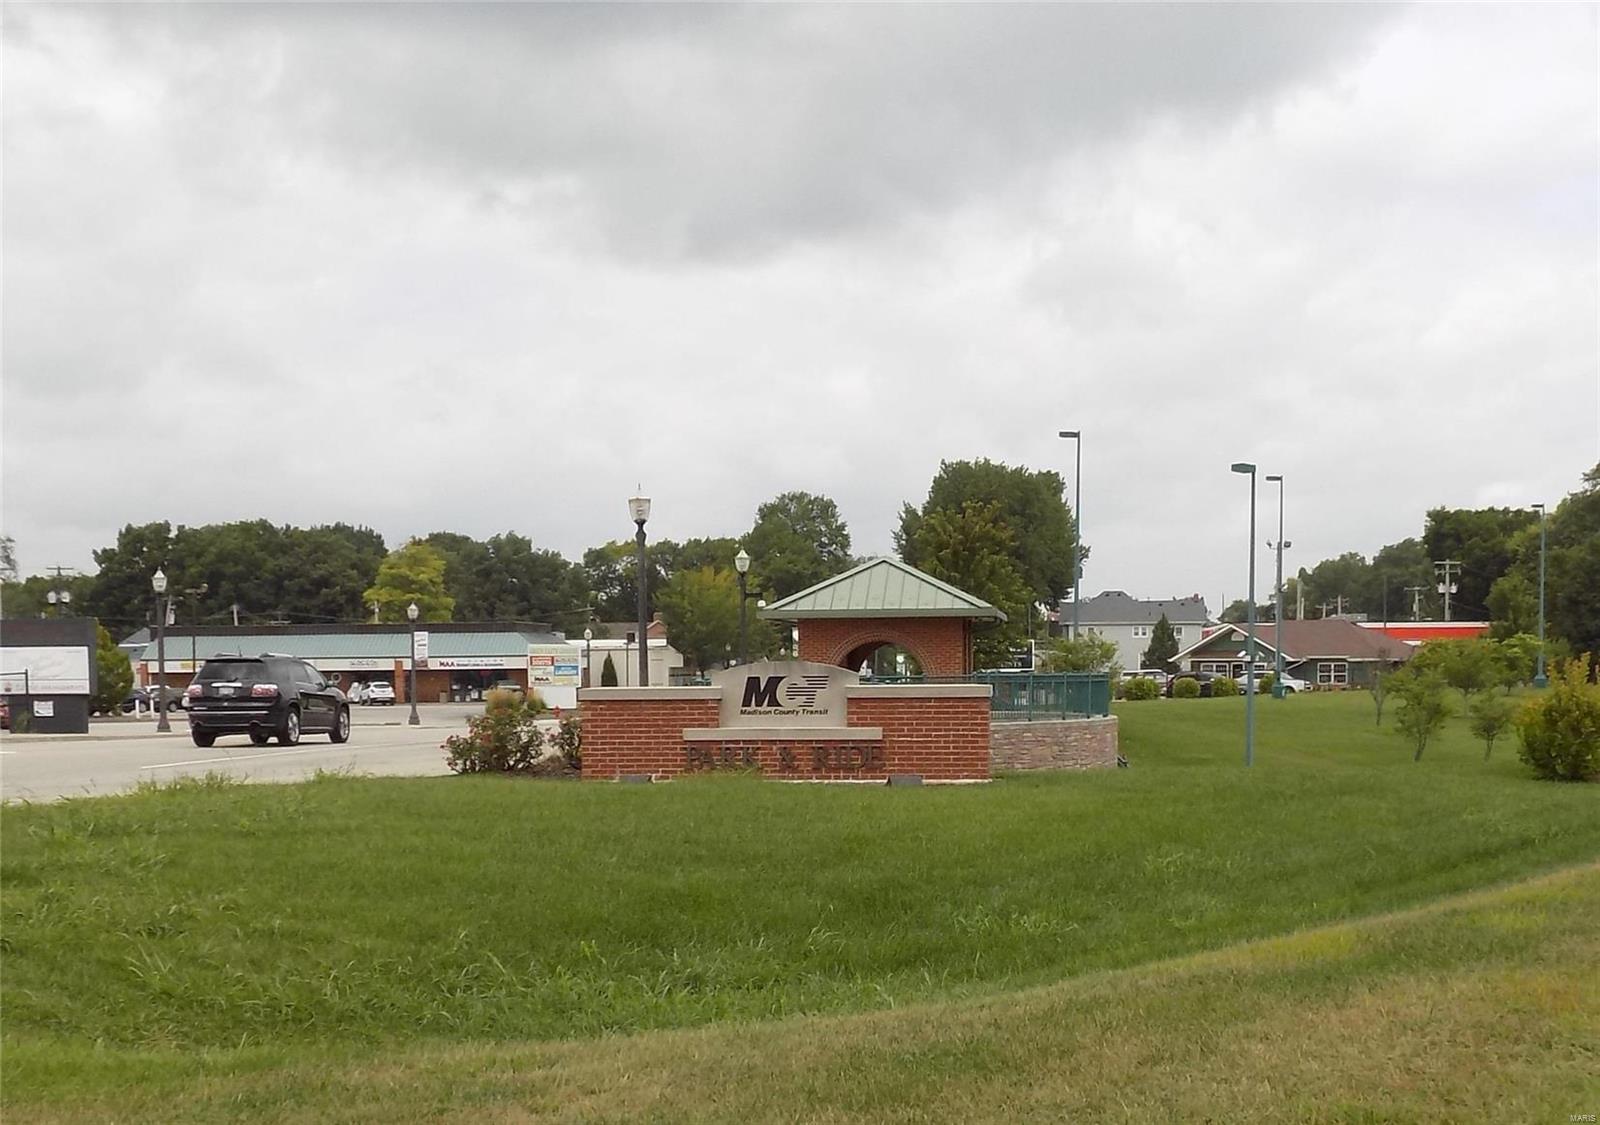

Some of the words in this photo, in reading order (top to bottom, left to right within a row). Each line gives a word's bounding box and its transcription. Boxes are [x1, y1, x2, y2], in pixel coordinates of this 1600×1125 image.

[773, 708, 800, 717] County
[801, 708, 829, 716] Transit
[686, 746, 761, 770] PARK
[776, 746, 797, 770] &
[812, 746, 883, 770] RIDE
